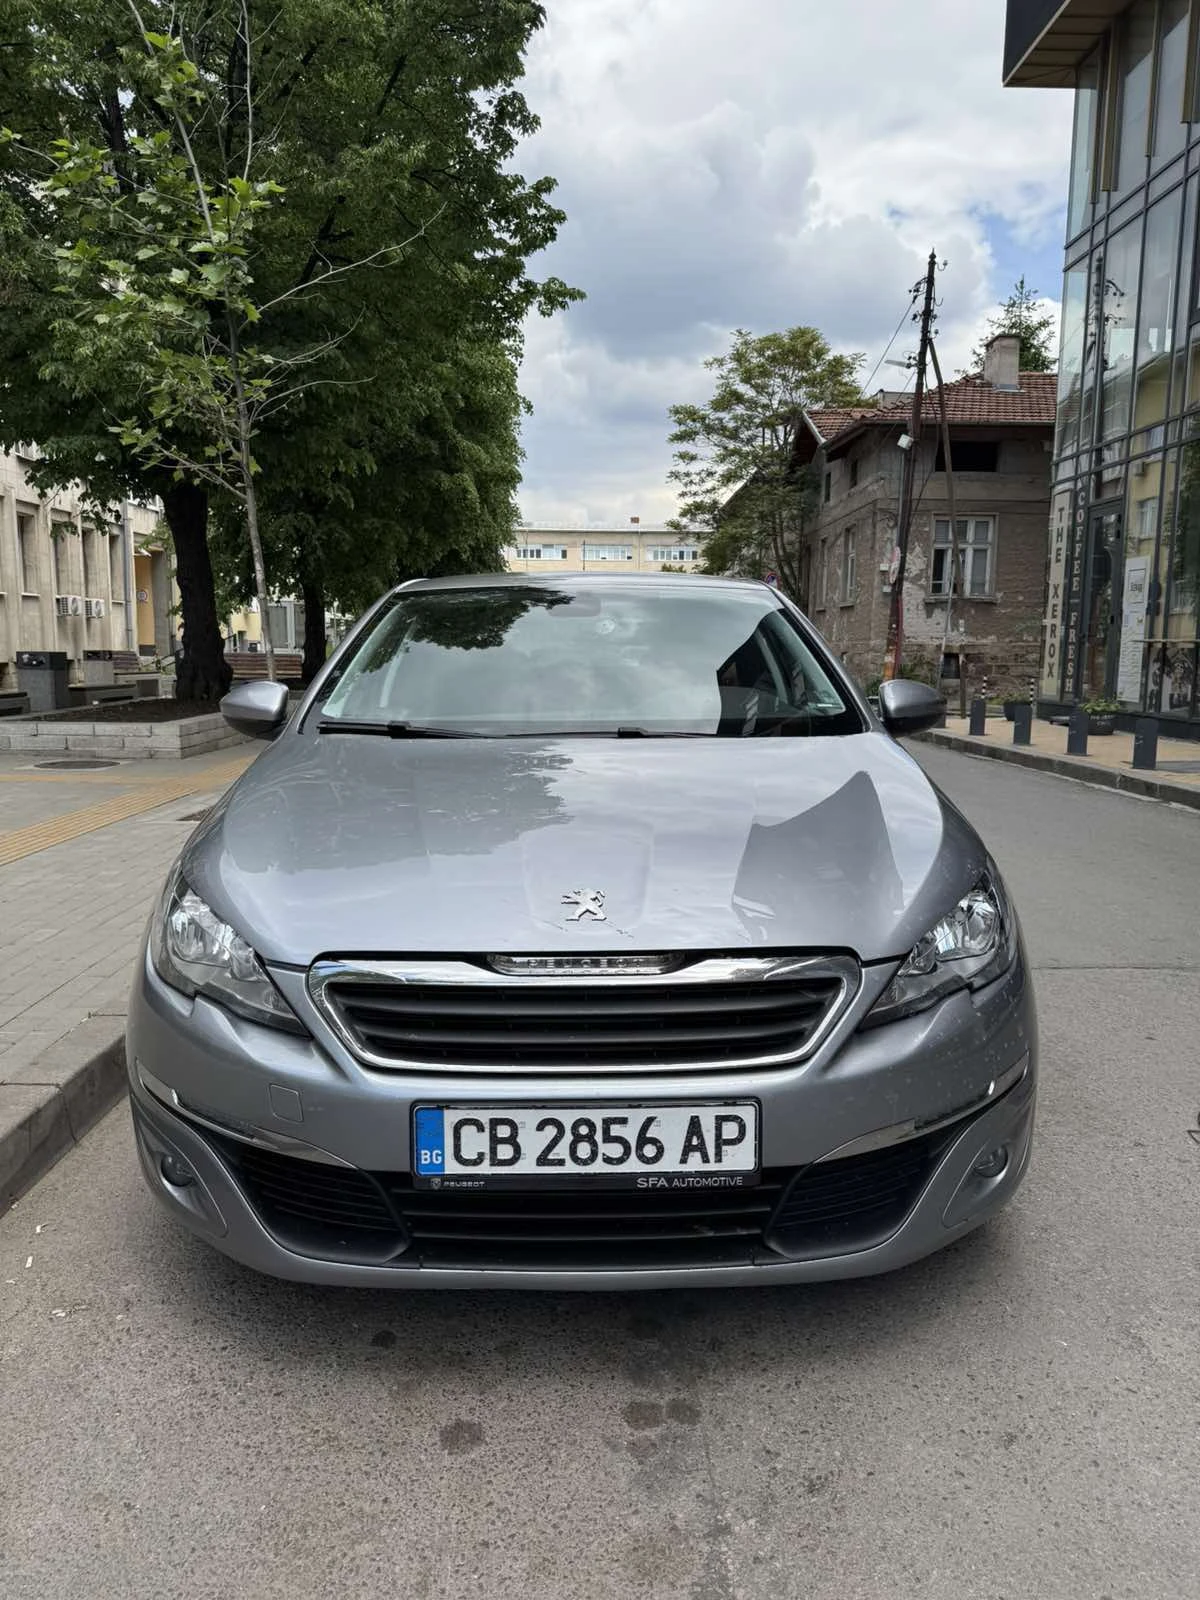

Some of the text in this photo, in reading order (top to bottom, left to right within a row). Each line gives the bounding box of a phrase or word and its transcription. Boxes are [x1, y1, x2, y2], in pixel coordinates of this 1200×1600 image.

[1072, 492, 1085, 591] COFFEE
[1047, 507, 1064, 678] THE XEROX
[1064, 612, 1078, 692] FRESH
[420, 1150, 442, 1165] BG
[452, 1114, 747, 1167] CB 2856 AP
[636, 1176, 743, 1188] SFA AUTOMOTIVE
